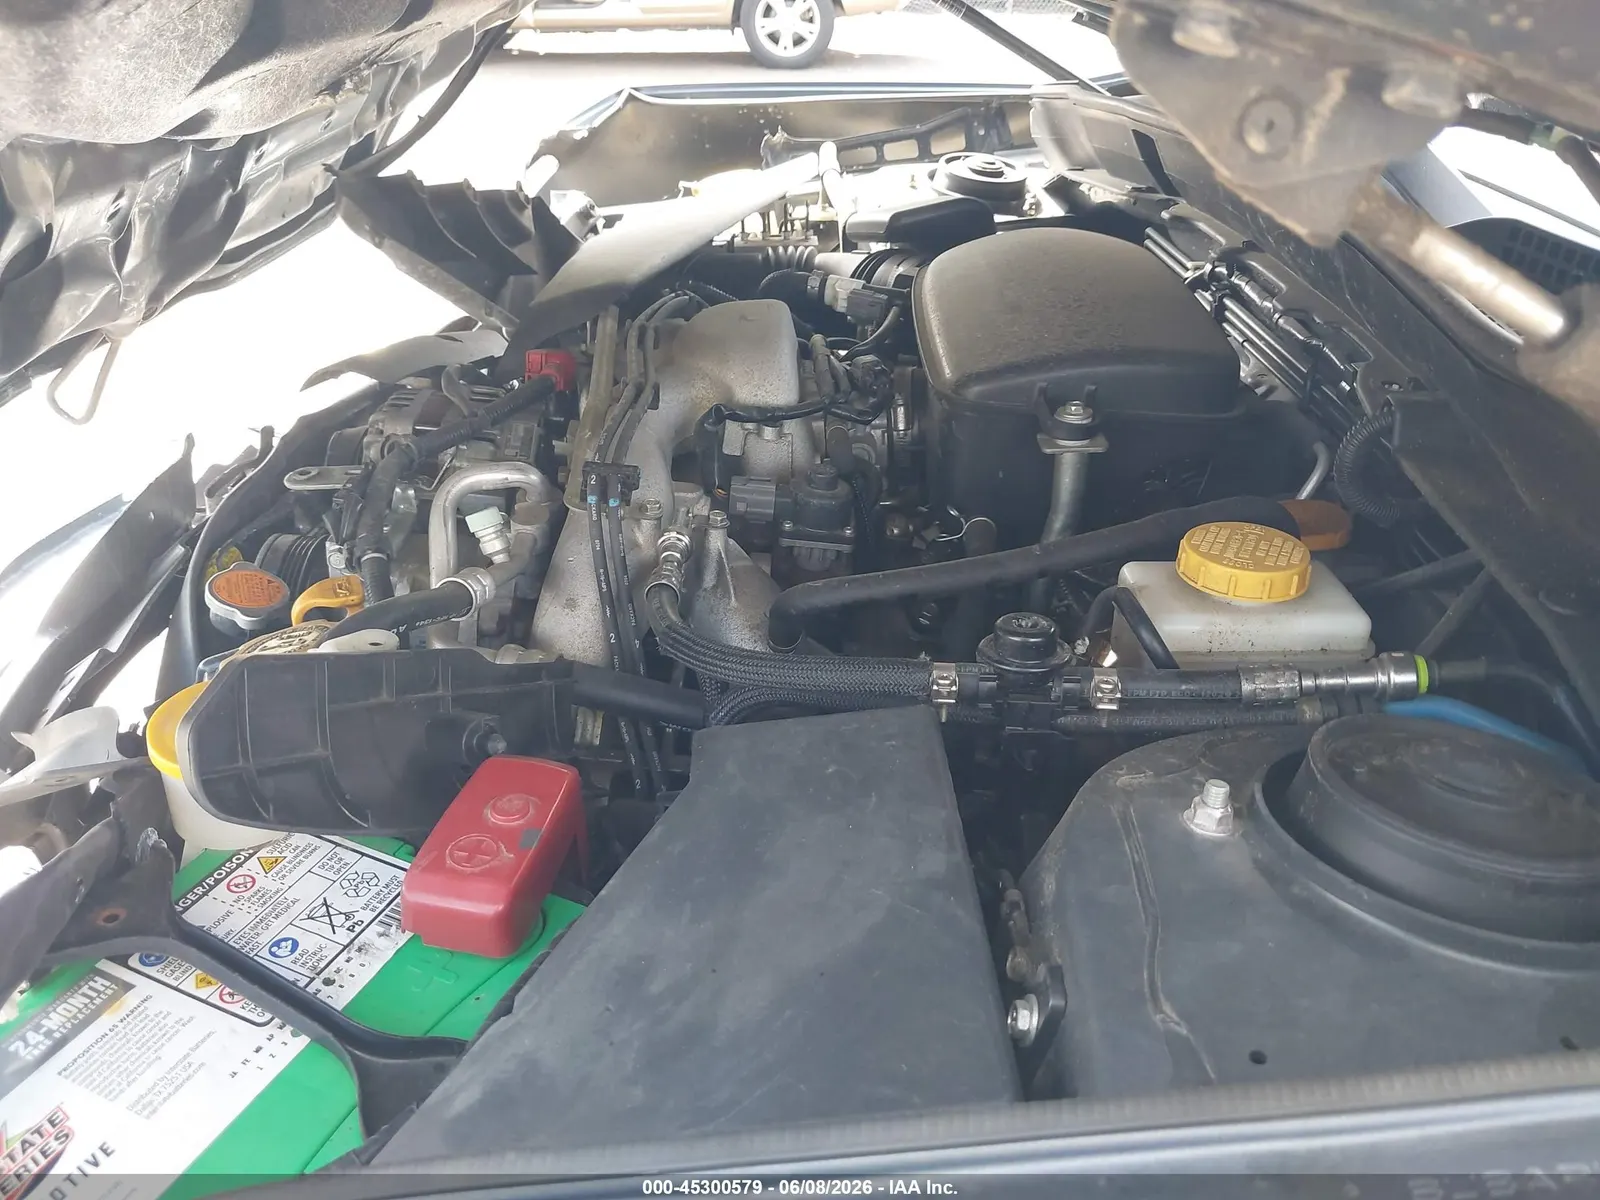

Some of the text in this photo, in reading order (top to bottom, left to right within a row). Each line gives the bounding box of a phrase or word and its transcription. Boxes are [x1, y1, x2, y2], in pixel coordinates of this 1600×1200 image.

[590, 474, 597, 484] 2
[609, 632, 616, 643] 2
[277, 842, 293, 855] ACID
[288, 844, 301, 854] CAN
[271, 841, 314, 878] CAUSE BLINDNESS
[318, 851, 341, 870] DO NOT
[325, 857, 344, 873] TIP OR
[332, 861, 352, 876] OPEN.
[278, 873, 287, 882] OR
[285, 857, 304, 875] SEVERE
[232, 894, 245, 904] NO
[244, 886, 266, 903] SPARKS
[250, 888, 273, 906] FLAMES
[257, 886, 283, 908] SMOKING
[360, 874, 400, 911] BATTERY MUST
[260, 920, 275, 931] GET
[271, 896, 301, 921] MEDICAL
[369, 905, 379, 913] BE
[232, 896, 290, 945] EYES IMMEDIATELY
[345, 919, 364, 933] Pb
[290, 948, 310, 966] READ
[8, 975, 112, 1057] 24-MONTH
[52, 982, 120, 1038] REPLACEMENT
[57, 1031, 109, 1077] PROPOSITION
[108, 1023, 119, 1033] 65
[117, 993, 154, 1024] WARNING
[0, 1111, 64, 1172] TATE
